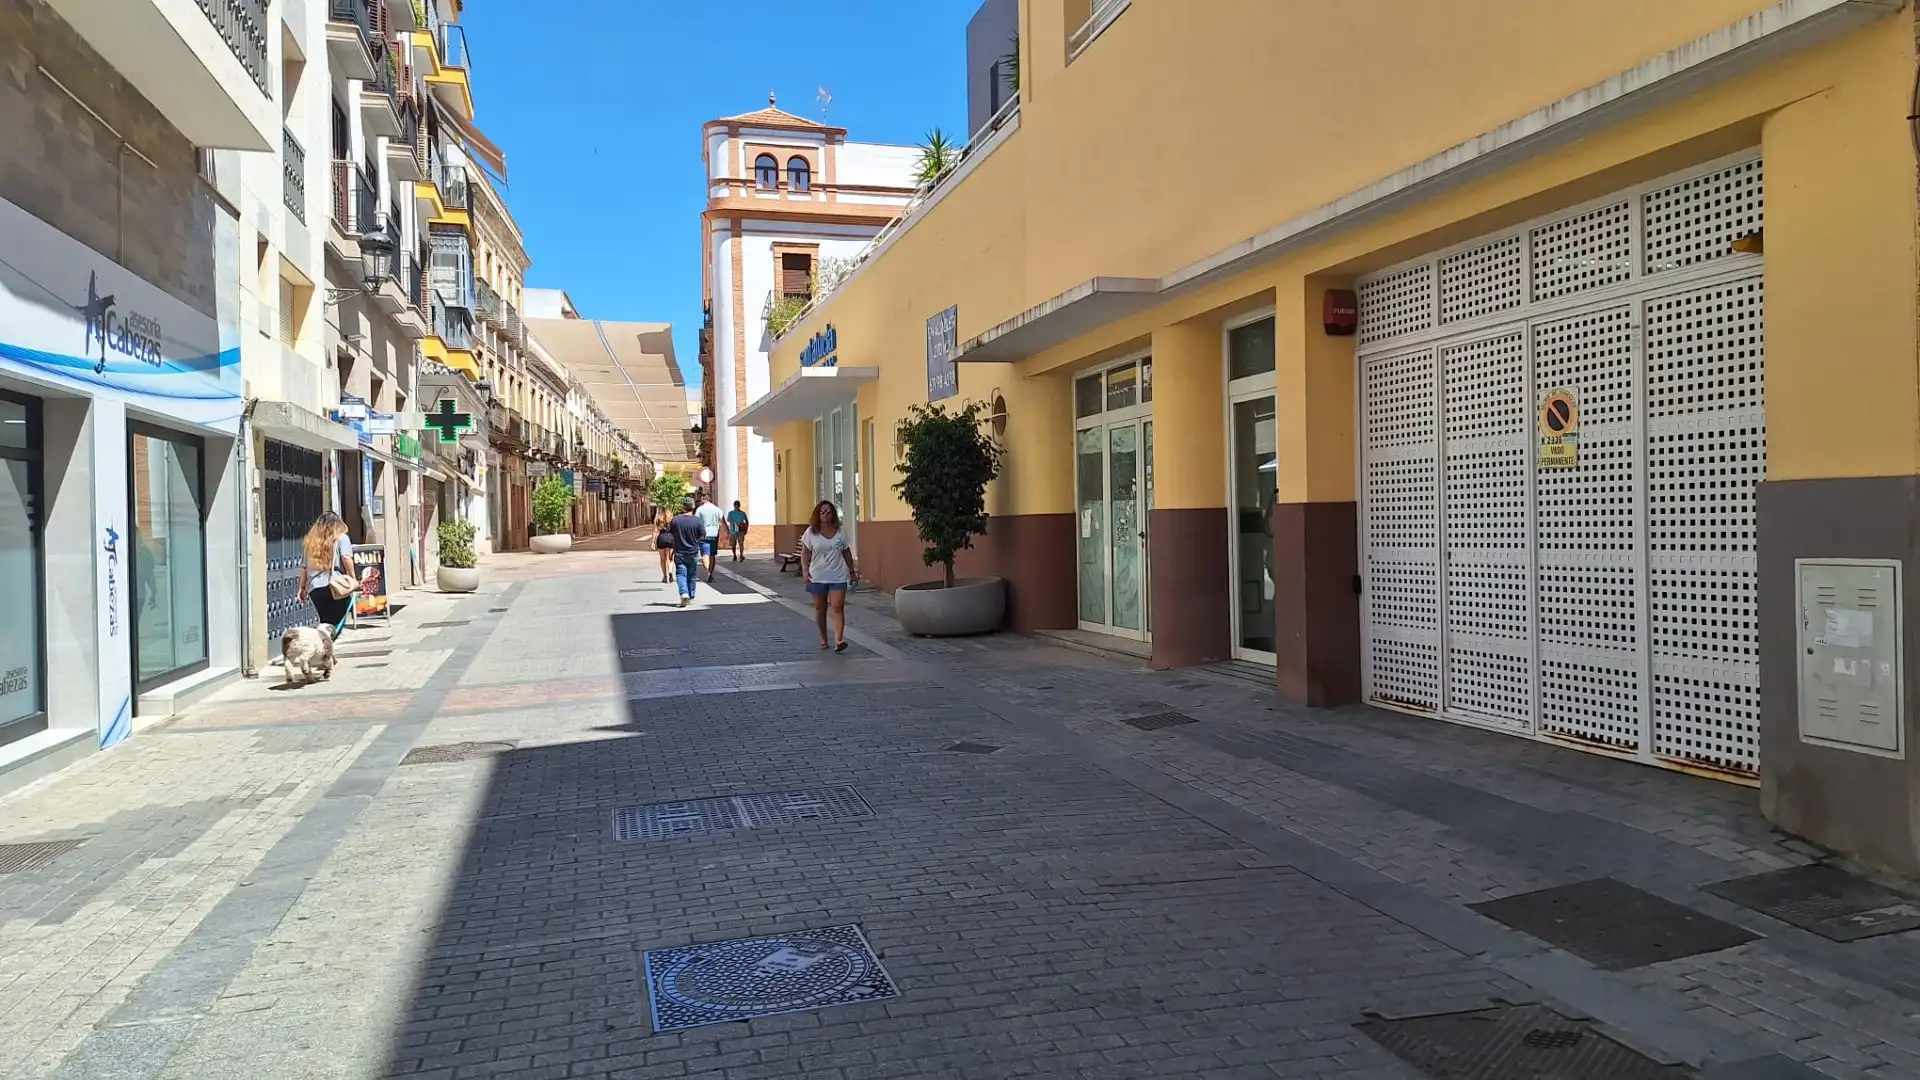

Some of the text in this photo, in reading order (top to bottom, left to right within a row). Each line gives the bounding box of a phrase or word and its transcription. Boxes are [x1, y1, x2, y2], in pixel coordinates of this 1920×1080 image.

[107, 310, 162, 368] Cabezas
[1541, 456, 1575, 466] PERMANENTE
[0, 676, 28, 696] abezas
